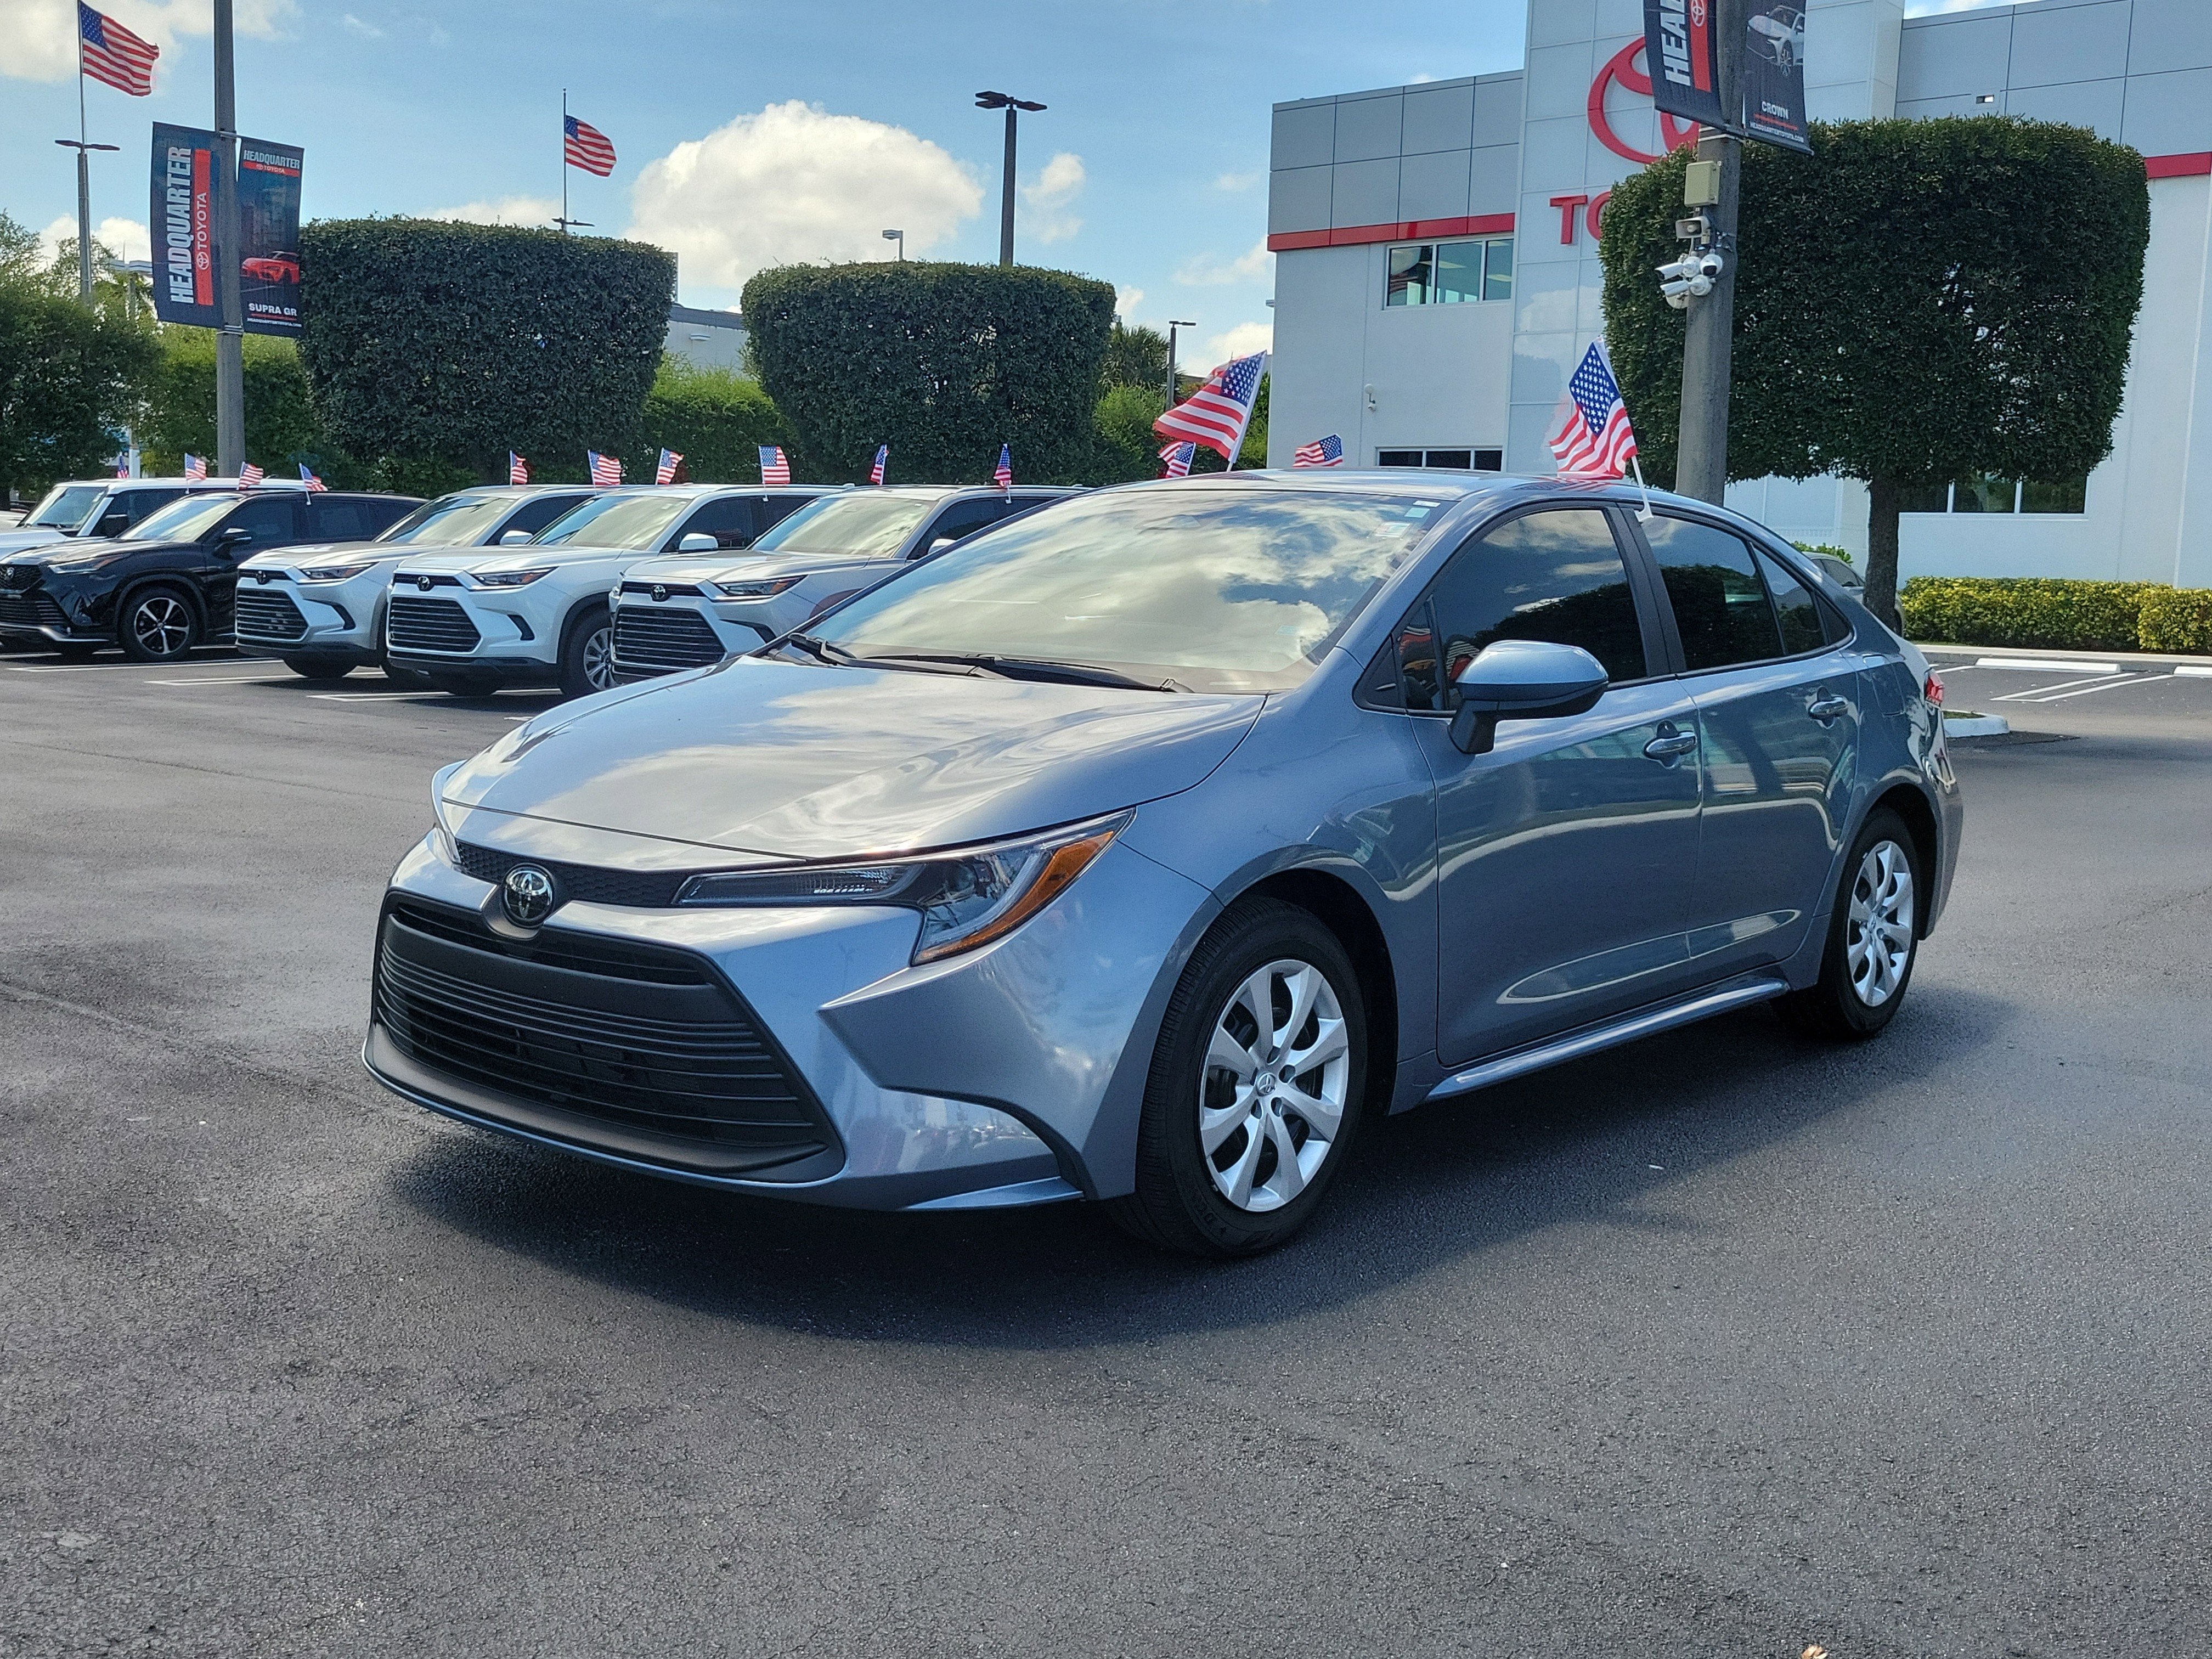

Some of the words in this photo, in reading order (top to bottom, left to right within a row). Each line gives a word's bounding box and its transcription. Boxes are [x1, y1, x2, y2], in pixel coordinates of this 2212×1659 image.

[1762, 101, 1788, 120] CROWN
[244, 150, 300, 170] HEADQUARTER
[264, 165, 285, 173] TOYOTA
[167, 146, 194, 303] HEADQUARTER
[196, 193, 207, 250] TOYOTA
[249, 303, 282, 314] SUPRA
[284, 307, 297, 317] GR
